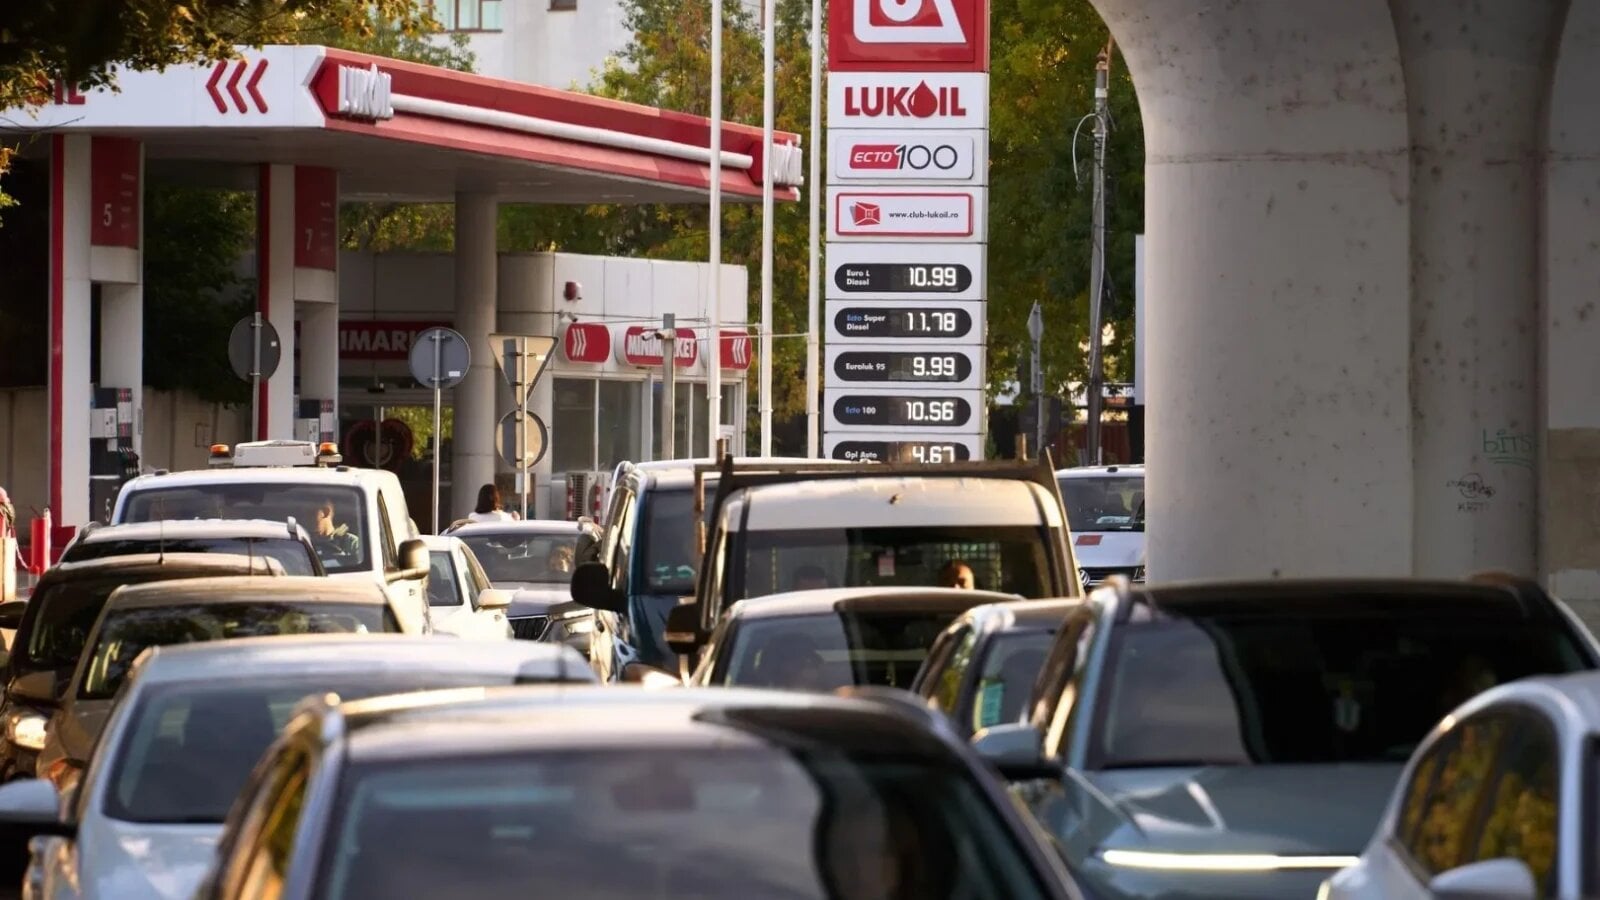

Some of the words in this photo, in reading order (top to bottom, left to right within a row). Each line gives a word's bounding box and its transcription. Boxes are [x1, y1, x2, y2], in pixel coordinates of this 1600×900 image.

[844, 79, 967, 118] LUKOIL
[854, 151, 892, 163] ECTO
[894, 145, 958, 170] 100
[103, 203, 112, 227] 5
[888, 210, 959, 218] www.club-lukoil.ro
[846, 269, 864, 277] Euro
[846, 278, 870, 286] Diesel
[909, 267, 957, 287] 10.99
[846, 323, 869, 331] Diesel
[863, 314, 886, 324] Super
[907, 312, 956, 332] 11.78
[913, 357, 955, 376] 9.99
[862, 406, 876, 414] 100
[905, 401, 954, 421] 10.56
[845, 451, 858, 460] Gpl
[912, 446, 955, 464] 4.67
